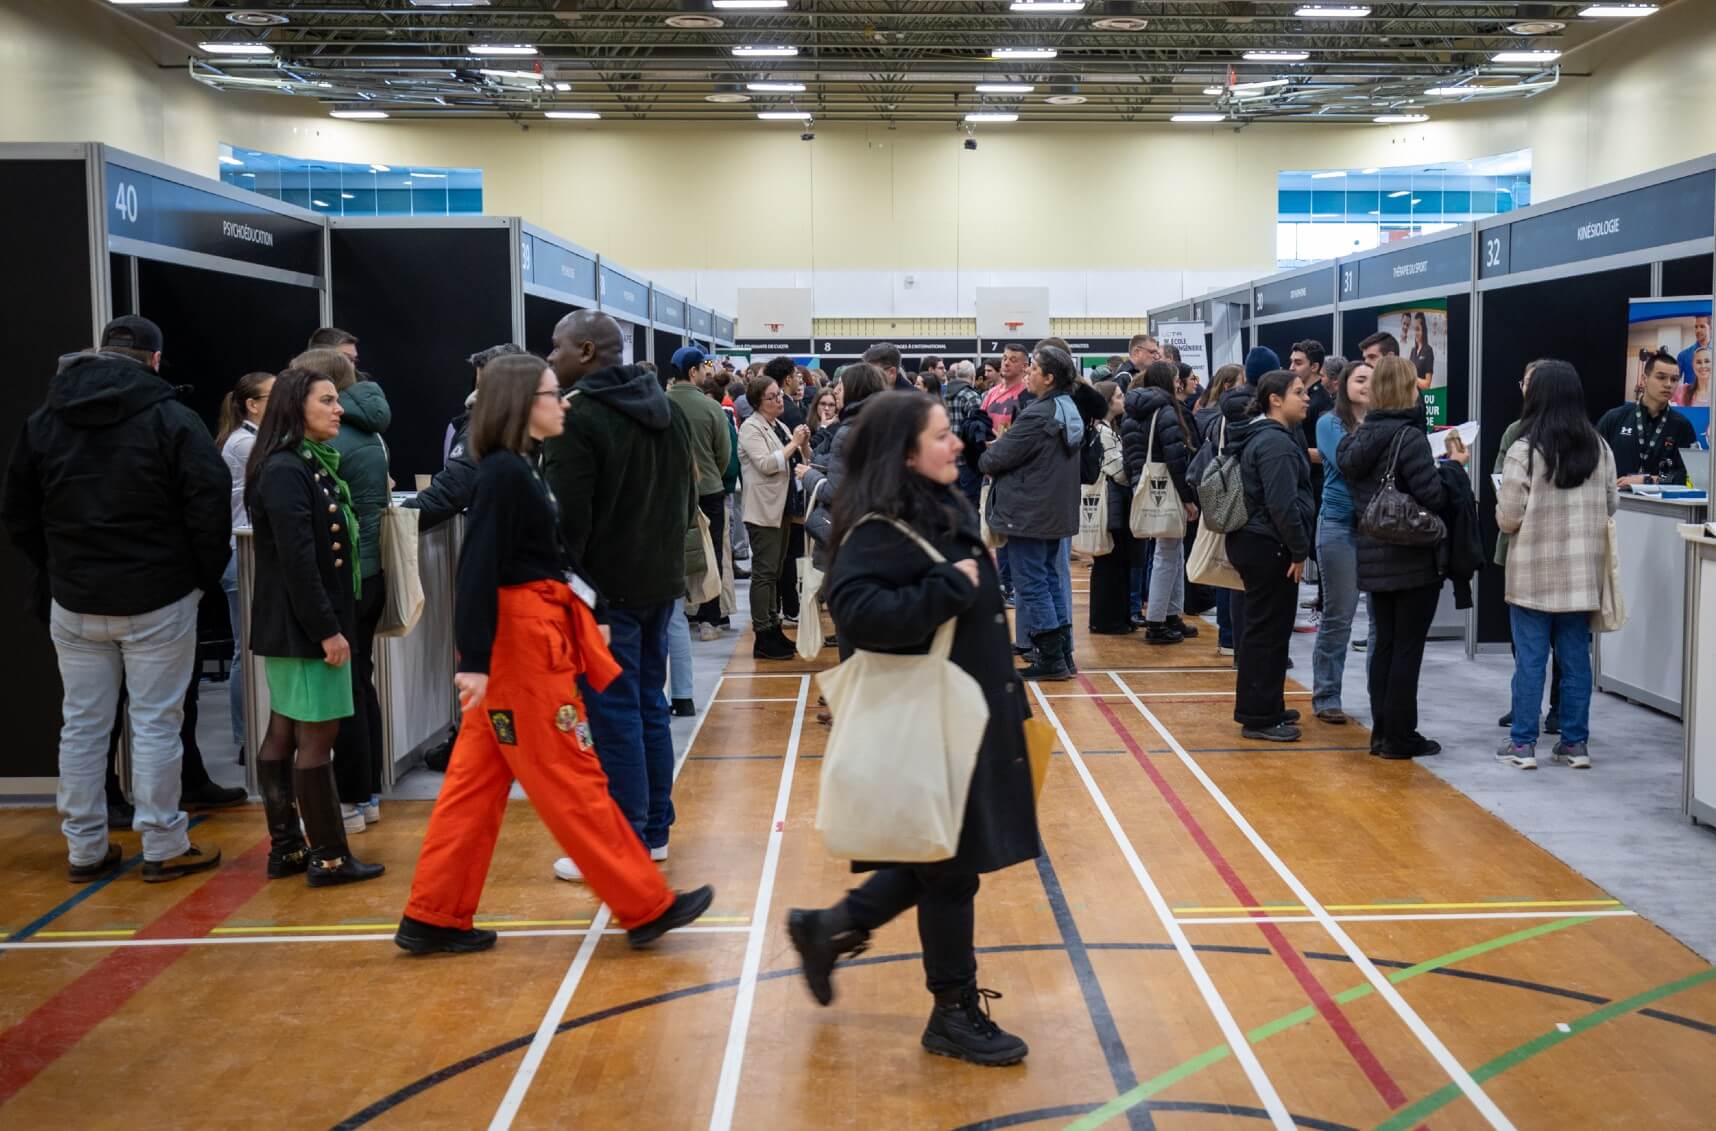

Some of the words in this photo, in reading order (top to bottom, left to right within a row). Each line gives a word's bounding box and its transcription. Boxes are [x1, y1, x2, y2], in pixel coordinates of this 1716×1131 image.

[115, 182, 138, 222] 40
[223, 220, 274, 247] PSYCHOÉDUCATION
[1577, 218, 1620, 241] KINÉSIOLOGIE
[1486, 238, 1500, 267] 32
[1344, 270, 1353, 293] 31
[824, 342, 832, 352] 8
[991, 342, 999, 351] 7
